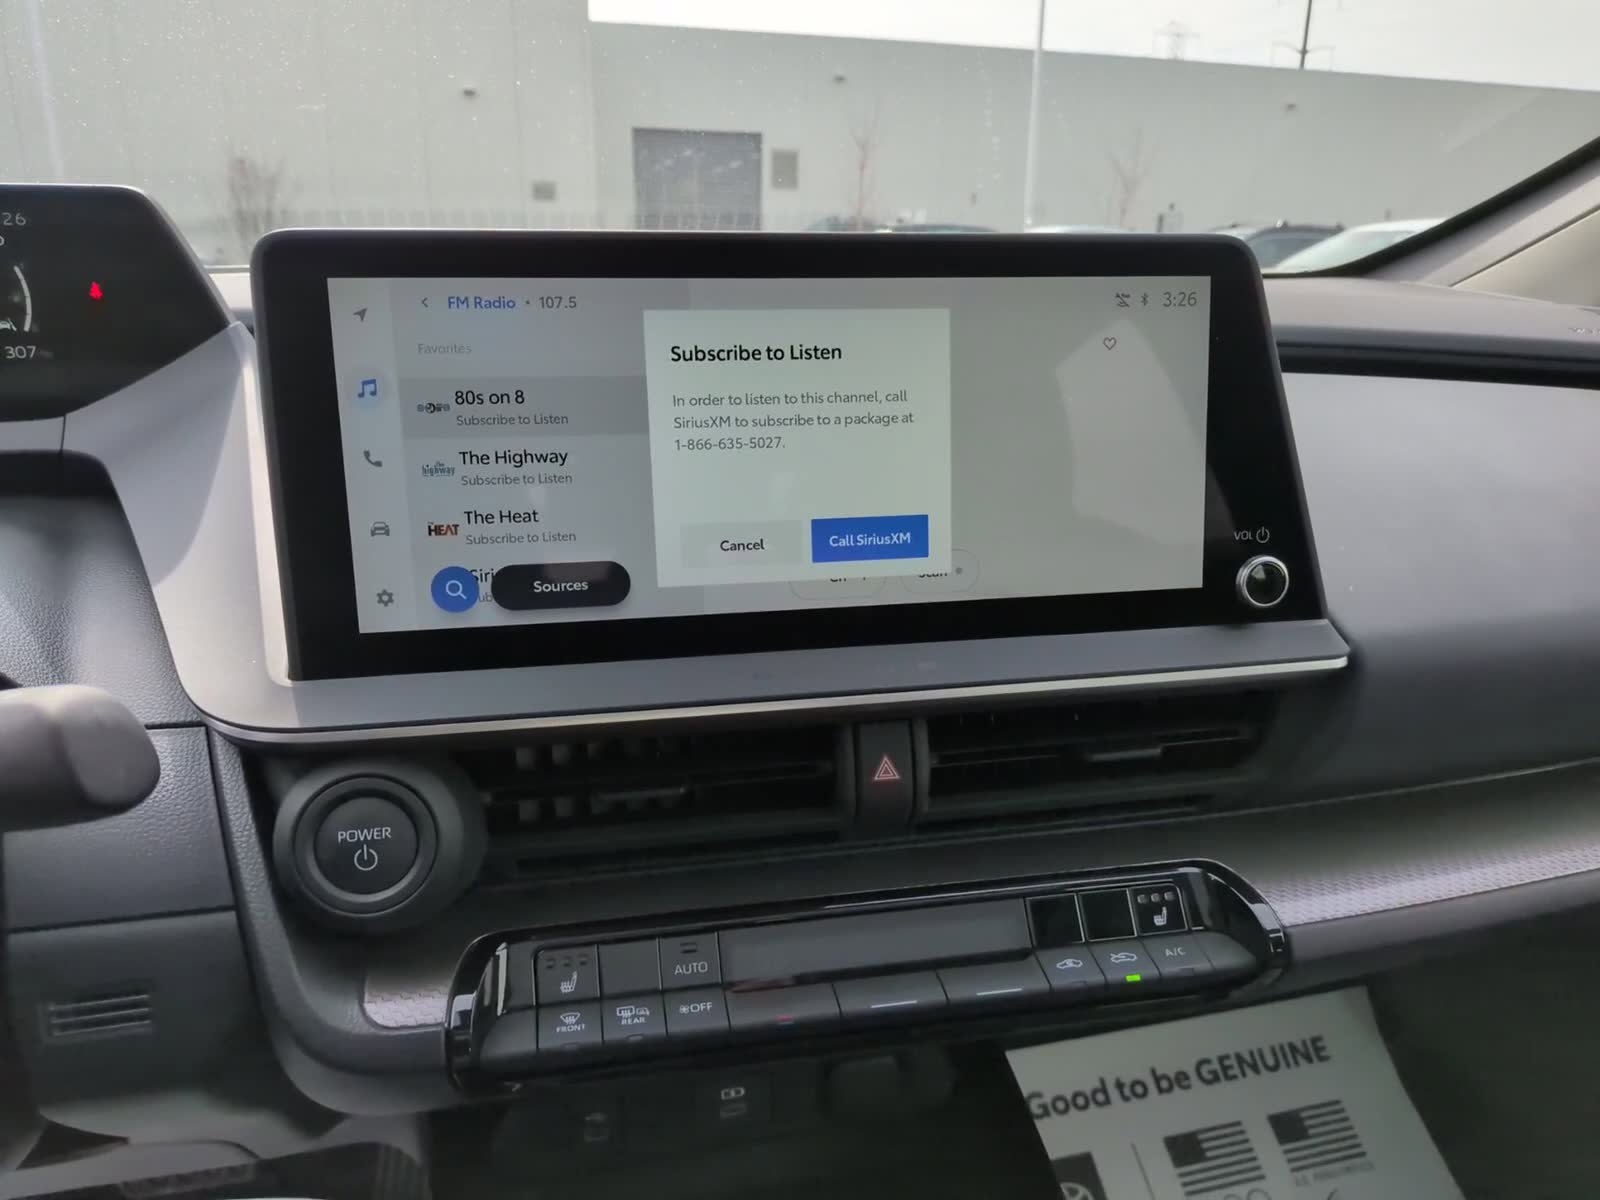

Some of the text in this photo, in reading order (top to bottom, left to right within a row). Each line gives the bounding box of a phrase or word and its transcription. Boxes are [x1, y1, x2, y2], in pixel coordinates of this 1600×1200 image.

[447, 295, 577, 310] FM Radio 107.5
[1163, 291, 1198, 307] 3:26
[4, 345, 37, 359] 307
[417, 343, 473, 355] Favorites
[670, 344, 842, 362] Subscribe to Listen
[454, 389, 525, 405] 80s on 8
[673, 390, 908, 407] In order to listen to this channel, call
[456, 413, 569, 426] Subscribe to Listen
[673, 412, 915, 429] SiriusXM to subscribe to a package at
[674, 436, 786, 451] 1-866-635-5027.
[459, 449, 568, 468] The Highway
[461, 473, 573, 486] Subscribe to Listen
[464, 509, 540, 525] The Heat
[466, 531, 577, 545] Subscribe to Listen
[829, 531, 911, 547] Call SiriusXM
[1233, 530, 1253, 540] VOL
[720, 538, 765, 552] Cancel
[533, 580, 589, 592] Sources
[338, 826, 392, 844] POWER
[1165, 947, 1186, 957] A/C
[674, 961, 708, 975] AUTO
[688, 1001, 713, 1013] OFF
[621, 1016, 646, 1025] REAR
[556, 1023, 586, 1033] FRONT
[1025, 1035, 1331, 1121] Good to be GENUINE
